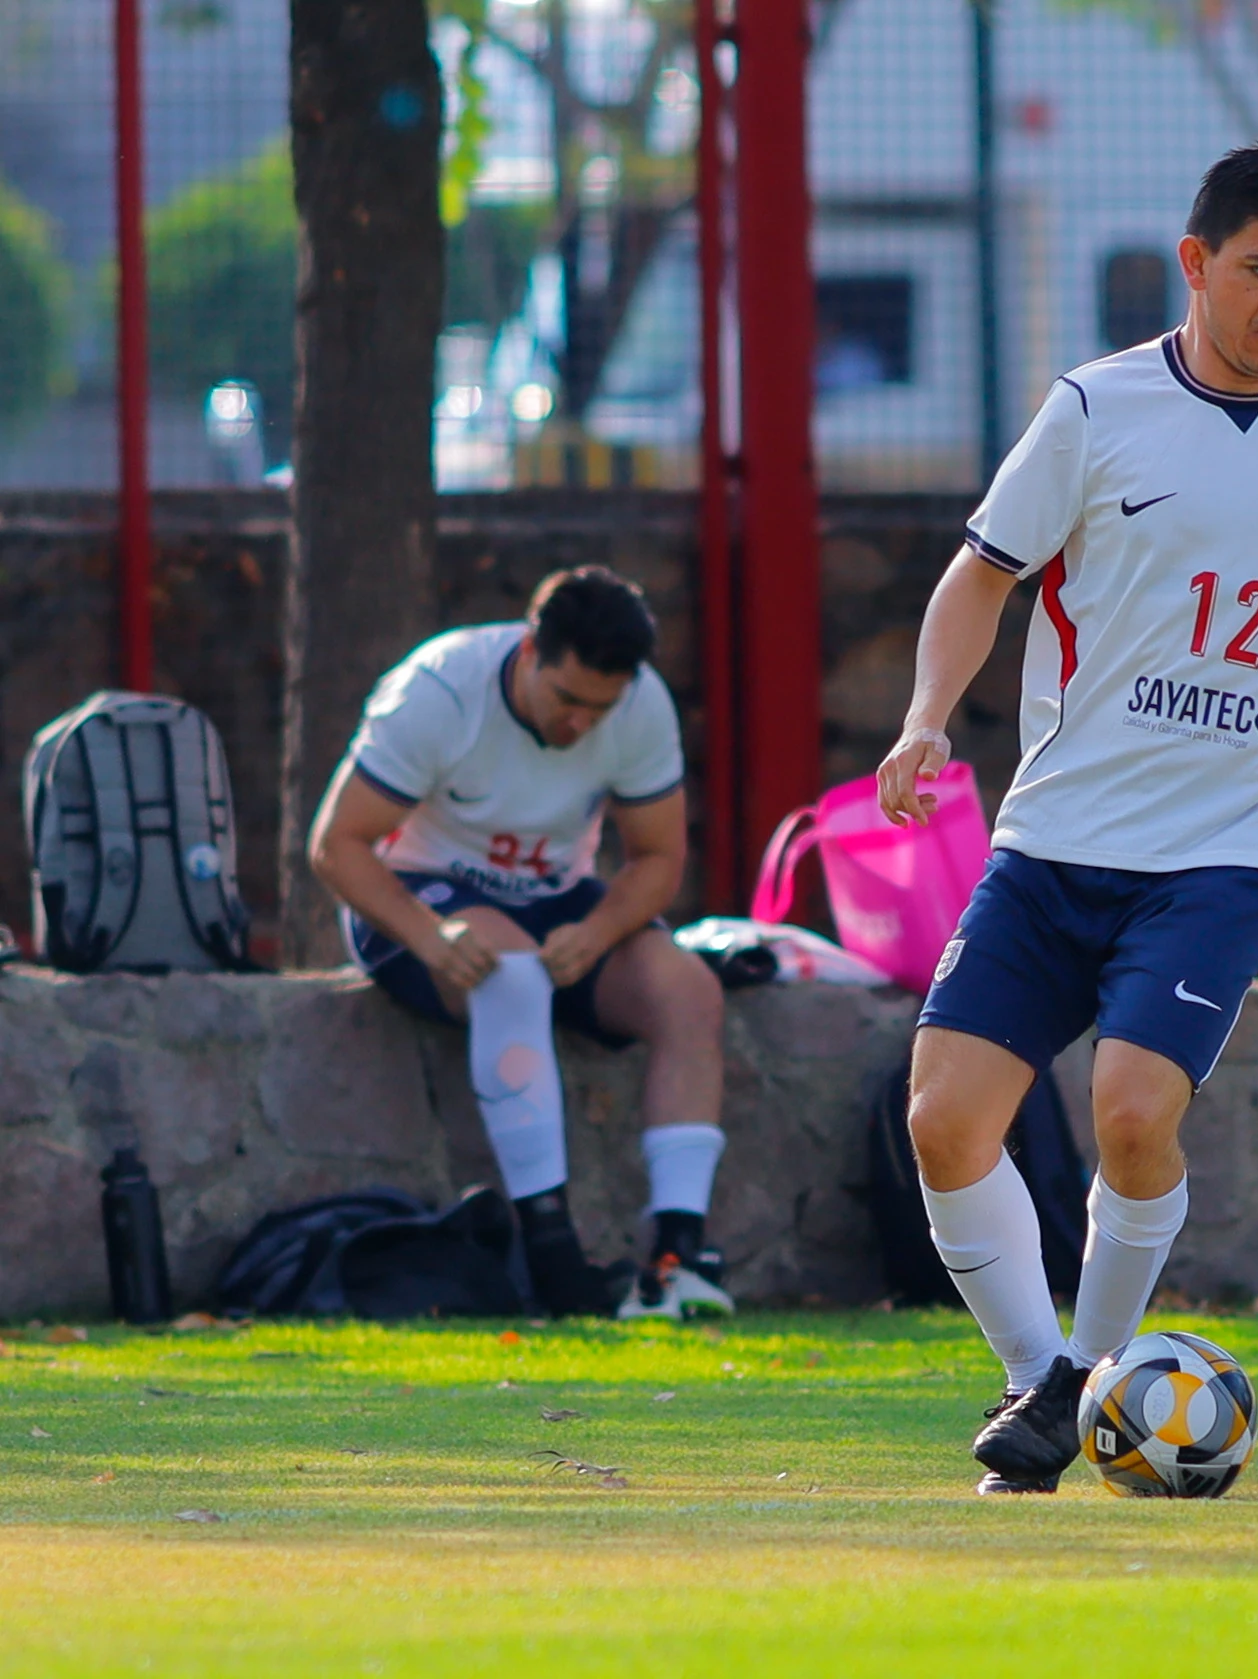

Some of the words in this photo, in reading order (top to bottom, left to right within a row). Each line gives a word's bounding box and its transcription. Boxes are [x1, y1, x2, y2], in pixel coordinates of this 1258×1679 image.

[1128, 676, 1255, 734] SAYATEC
[1122, 716, 1150, 730] Calidad
[1192, 730, 1211, 741] para
[1213, 732, 1223, 744] tu
[1223, 735, 1249, 750] Hogar
